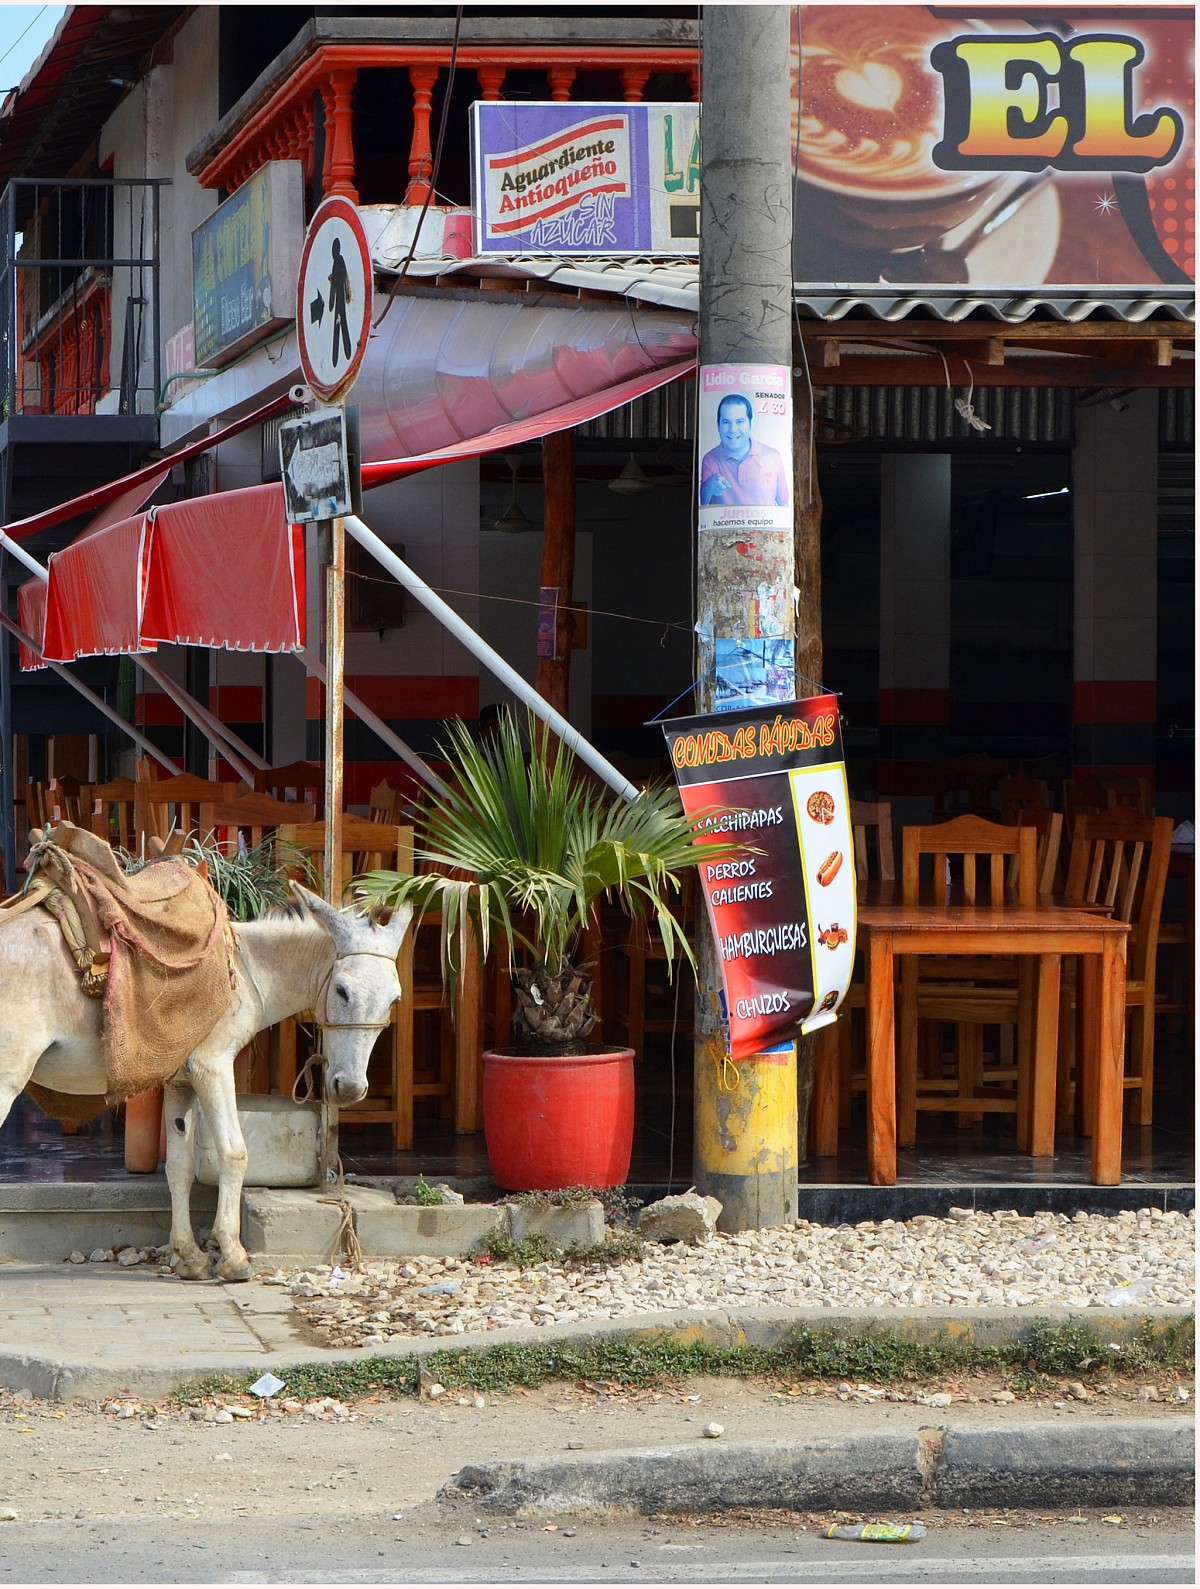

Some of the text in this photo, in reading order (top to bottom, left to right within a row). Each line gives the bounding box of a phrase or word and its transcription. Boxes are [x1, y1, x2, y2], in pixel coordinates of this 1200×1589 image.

[940, 35, 1181, 166] EL
[501, 139, 616, 192] Aguardiente
[499, 157, 617, 214] Antioqueño
[578, 192, 616, 221] SIN
[530, 211, 618, 247] AZÚCAR
[705, 372, 736, 386] Lidio
[772, 401, 786, 415] 30
[713, 519, 745, 527] hacemos
[747, 518, 774, 527] equipo
[720, 507, 766, 519] Juntos
[673, 714, 835, 768] COMIDAS RÁPIDAS
[706, 858, 757, 883] PERROS
[711, 881, 773, 906] CALIENTES
[719, 922, 808, 961] HAMBURGUESAS
[736, 991, 792, 1020] CHUZOS
